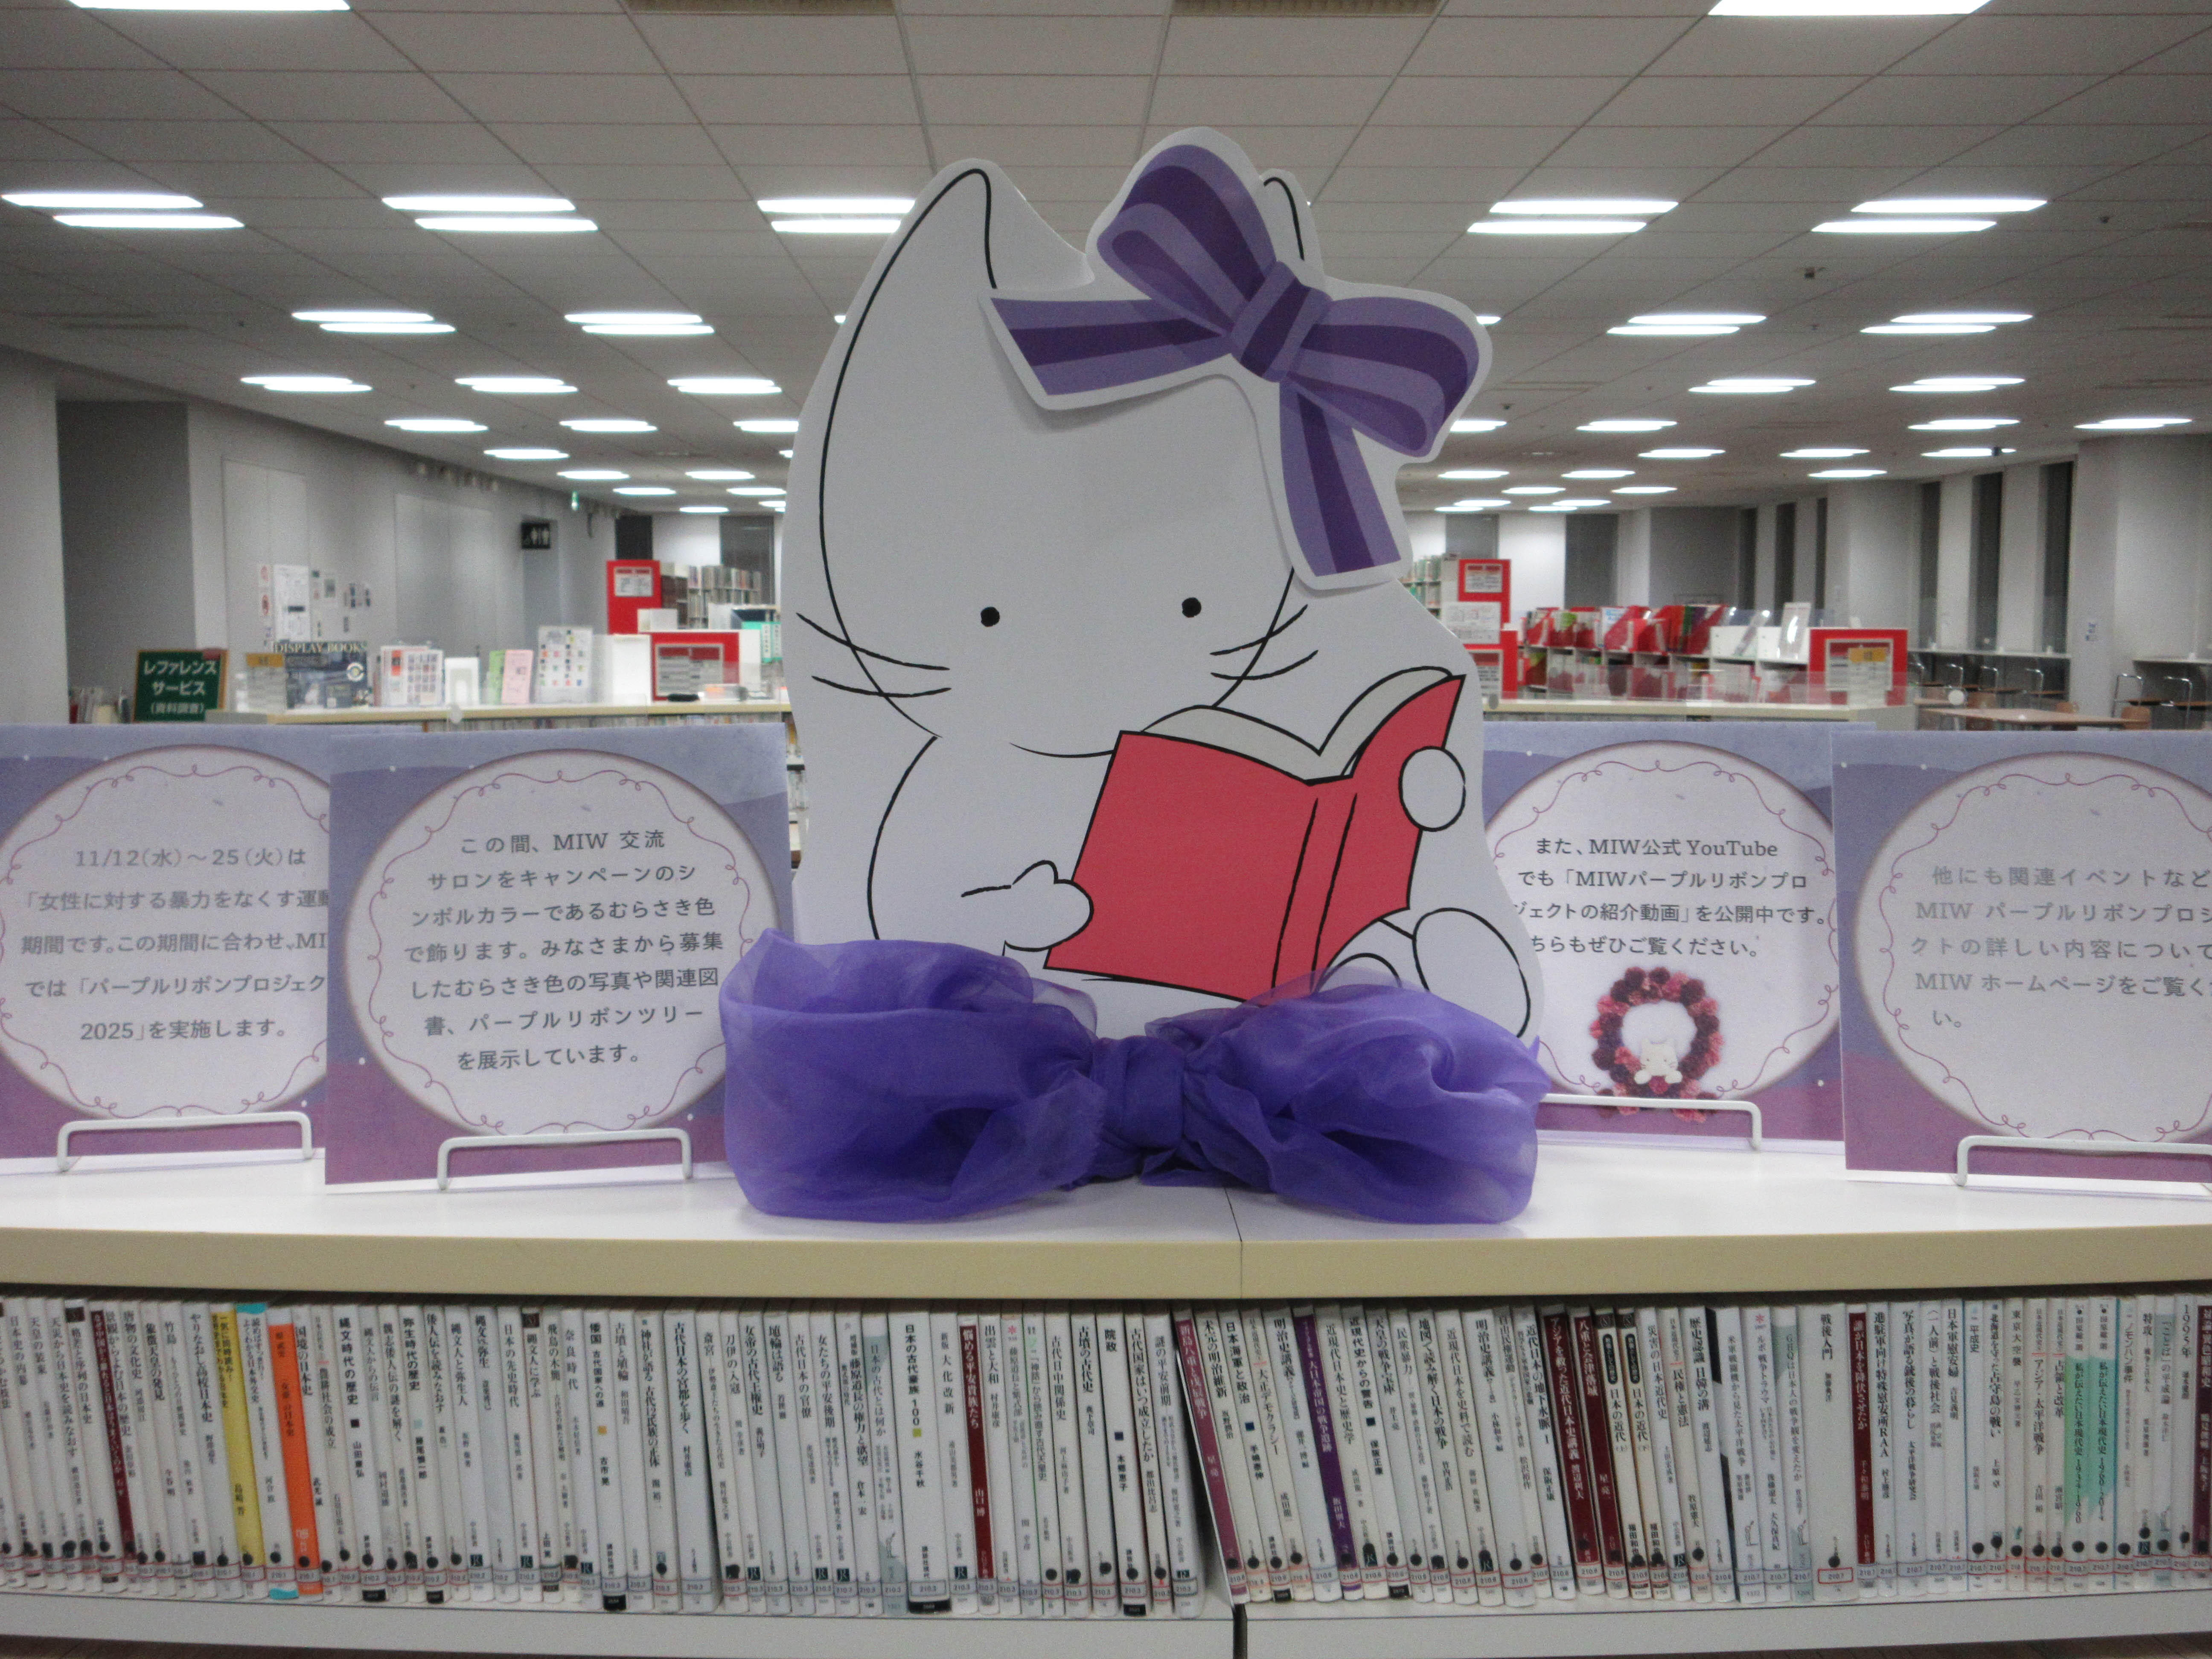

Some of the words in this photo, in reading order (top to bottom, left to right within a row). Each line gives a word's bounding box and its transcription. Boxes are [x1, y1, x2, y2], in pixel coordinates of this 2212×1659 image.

[144, 660, 217, 675] レファレンス
[152, 681, 206, 696] サービス
[428, 864, 696, 891] サロンをキャンペーンのシ
[1686, 839, 1779, 857] YouTube
[1932, 866, 2210, 888] 他にも関連イベントなど
[1518, 869, 1807, 890] でも「MIWパープルリボンプロ
[412, 897, 716, 927] ンボルカラーであるむらさき色
[1915, 902, 1973, 920] MIW
[404, 932, 724, 963] で飾ります。みなさまから募集
[1531, 935, 1758, 958] ちらもぜひご覧ください。
[412, 967, 719, 1000] したむらさき色の写真や関連図
[1915, 973, 1973, 991] MIW
[1981, 974, 2212, 998] ホームページをご覧く
[80, 1020, 285, 1041] 2025」を実施します。
[424, 1005, 703, 1038] 書、パープルリボンツリー
[1933, 1010, 1962, 1028] い。
[457, 1044, 639, 1071] を展示しています。
[165, 1321, 177, 1344] 竹島
[403, 1317, 421, 1391] 弥生時代の歴史
[547, 1323, 561, 1382] 飛鳥の木簡
[590, 1322, 602, 1345] 倭国
[615, 1322, 629, 1382] 古墳と埴輪
[768, 1324, 783, 1382] 埴輪は語る
[1104, 1328, 1118, 1352] 院政
[1274, 1318, 1296, 1377] 明治史講義
[1397, 1327, 1412, 1375] 民衆暴力
[1476, 1318, 1495, 1377] 明治史講義
[1499, 1316, 1515, 1374] 自由民権運動
[1689, 1316, 1706, 1364] 歴史認識
[1820, 1313, 1834, 1361] 戦後入門
[2123, 1323, 2134, 1383] ノモンハン事件
[2142, 1313, 2153, 1336] 特攻
[339, 1317, 359, 1405] 縄文時代の歴史
[364, 1327, 379, 1402] 縄文人からの伝言
[383, 1323, 402, 1443] 魏志倭人伝の謎を解く
[427, 1313, 445, 1414] 倭人伝を読みなおす
[451, 1323, 468, 1406] 縄文人と弥生人
[504, 1324, 520, 1408] 日本の先史時代
[527, 1333, 541, 1398] 縄文人に学ぶ
[565, 1329, 579, 1390] 奈良時代
[593, 1350, 604, 1408] 古代国家への道
[675, 1322, 691, 1434] 古代日本の宮都を歩く
[726, 1334, 741, 1394] 刀伊の入寇
[745, 1324, 764, 1416] 女帝の古代王権史
[795, 1333, 811, 1419] 古代日本の官僚
[818, 1334, 835, 1428] 女たちの平安後期
[942, 1354, 955, 1415] 大化改新
[963, 1329, 979, 1429] 悩める平安貴族たち
[984, 1325, 999, 1385] 出雲と大和
[1009, 1347, 1023, 1417] 藤原道長と紫式部
[1052, 1335, 1066, 1421] 古代日中関係史
[1078, 1325, 1094, 1394] 古墳の古代史
[1155, 1336, 1171, 1407] 謎の平安前期
[1204, 1319, 1228, 1398] 未完の明治維新
[1226, 1322, 1251, 1404] 日本海軍と政治
[1326, 1324, 1355, 1445] 近現代日本史と歴史学
[1349, 1317, 1374, 1409] 近現代史からの警告
[1375, 1318, 1396, 1396] 天皇の戦争宝庫
[1418, 1318, 1448, 1450] 地図で読み解く日本の戦争
[1526, 1324, 1551, 1431] 近代日本の地下水脈
[1580, 1319, 1599, 1397] 八重と会津落城
[1647, 1324, 1668, 1420] 災害の日本近代史
[1758, 1353, 1770, 1404] 戦争トラウマ
[850, 1358, 869, 1466] 藤原道長の権力と欲望
[870, 1345, 886, 1437] 日本の古代とは何か
[1131, 1328, 1154, 1463] 古代国家はいつ成立したか
[1259, 1368, 1280, 1455] 大正デモクラシー
[1447, 1327, 1474, 1458] 近現代日本を史料で読む
[1550, 1317, 1580, 1461] アジアを救った近代日本史講義
[1610, 1388, 1627, 1443] 日本の近代
[1633, 1388, 1648, 1442] 日本の近代
[1673, 1368, 1690, 1428] 民権と憲法
[1696, 1367, 1710, 1412] 日韓の溝
[2033, 1359, 2045, 1455] アジア・太平洋戦争
[2054, 1359, 2064, 1418] 占領と改革
[914, 1450, 926, 1488] 水谷千秋
